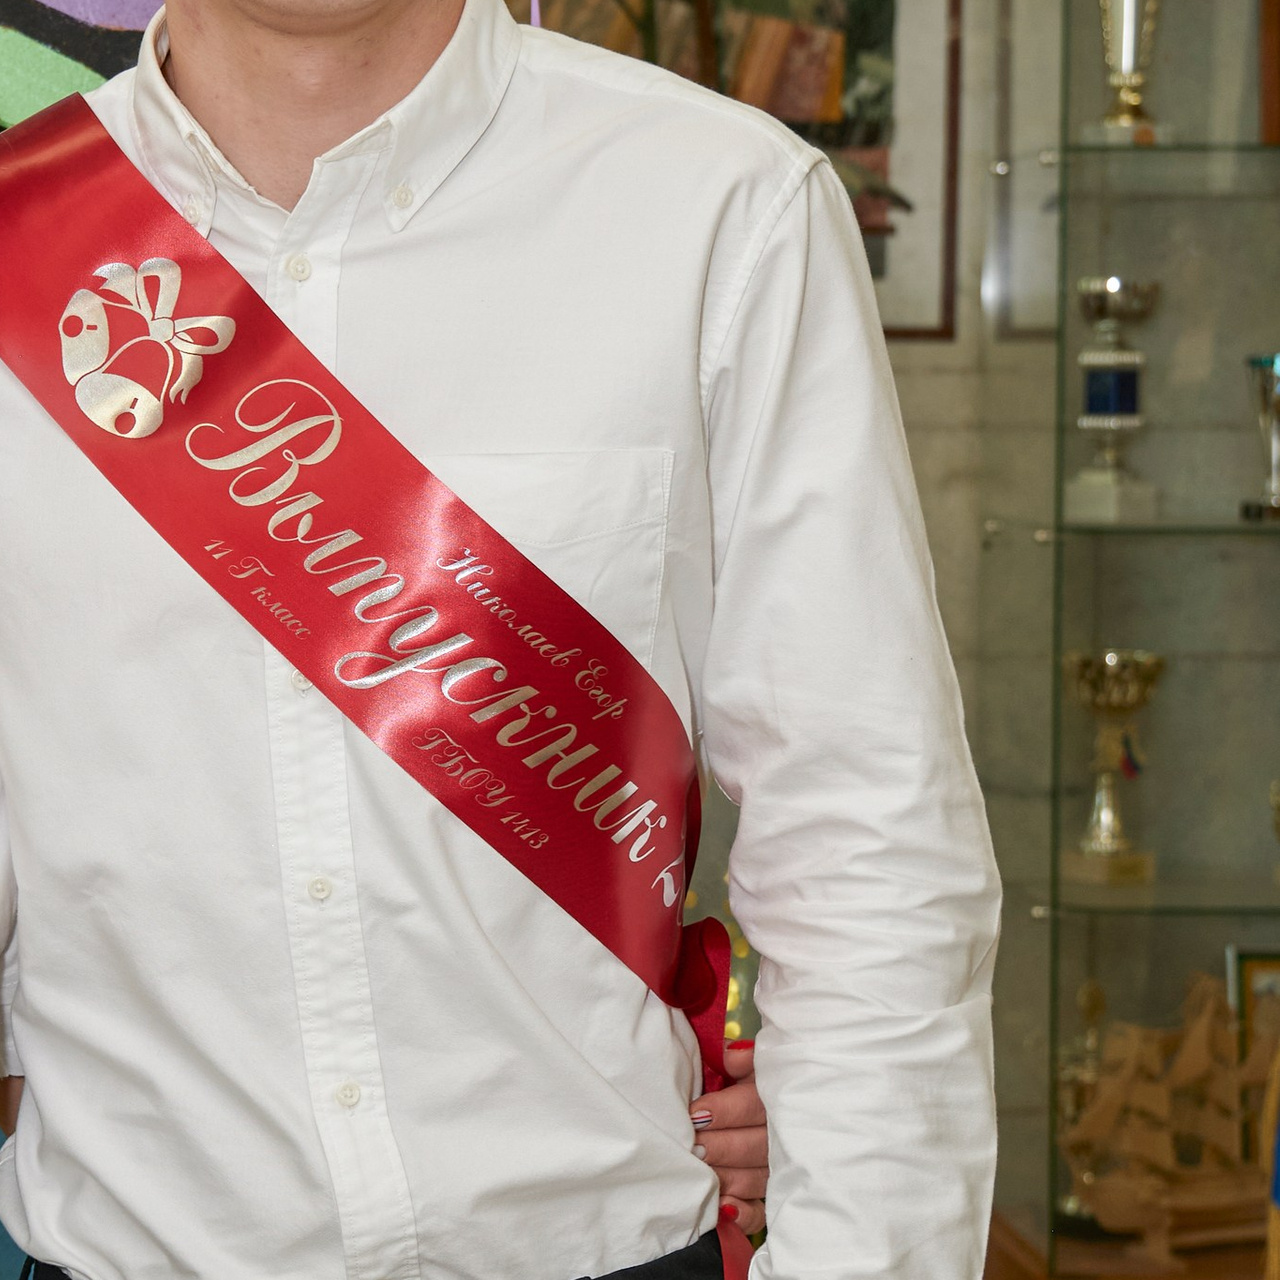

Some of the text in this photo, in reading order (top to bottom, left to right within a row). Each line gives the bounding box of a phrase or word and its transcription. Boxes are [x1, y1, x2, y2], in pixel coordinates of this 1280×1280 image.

[185, 378, 667, 863] Выпускник
[204, 539, 233, 560] 11
[250, 586, 311, 640] класс
[436, 547, 628, 720] Николаев Егор
[411, 727, 550, 849] ГБОУ 1413
